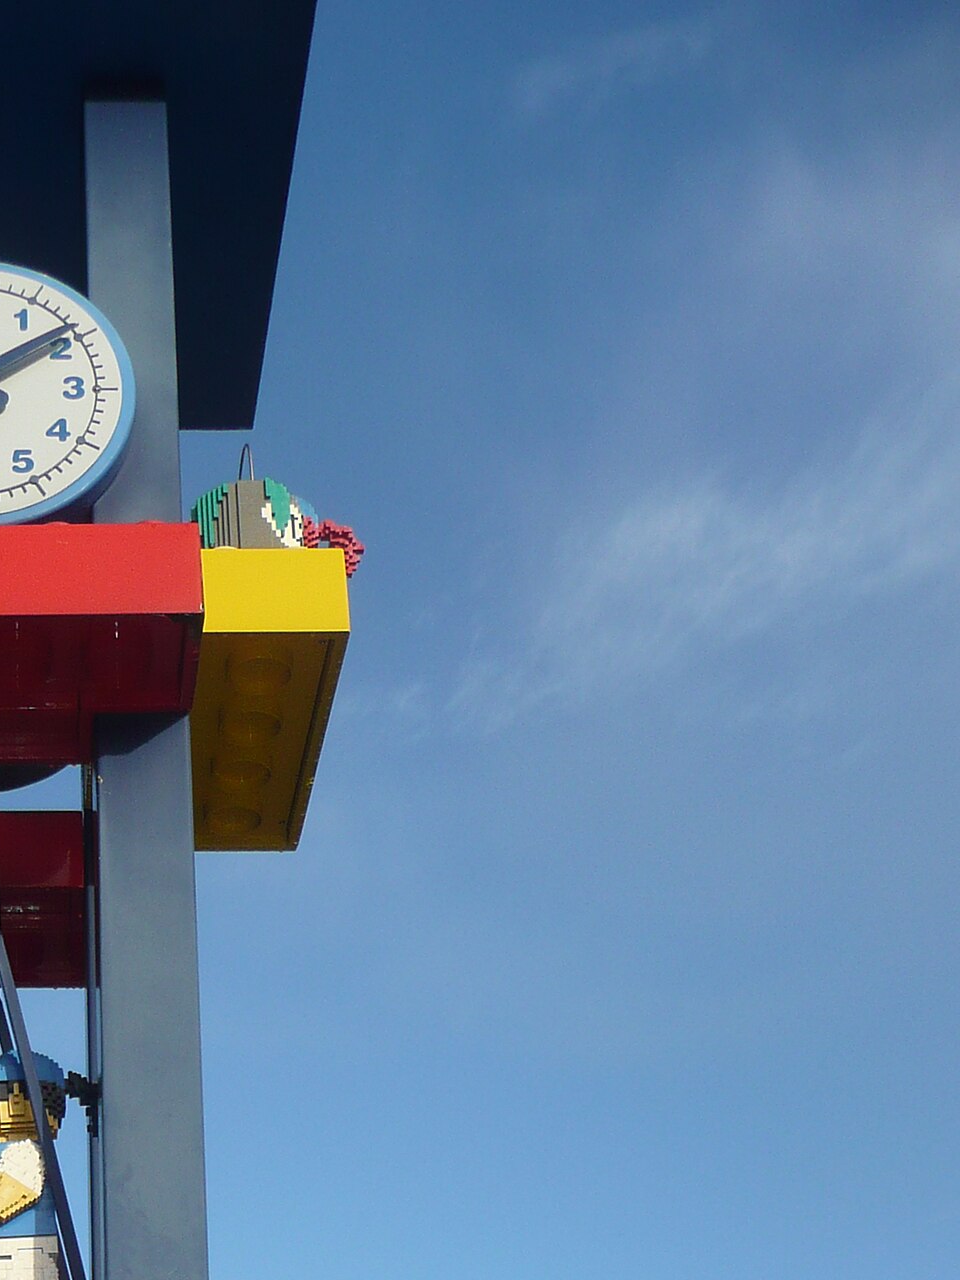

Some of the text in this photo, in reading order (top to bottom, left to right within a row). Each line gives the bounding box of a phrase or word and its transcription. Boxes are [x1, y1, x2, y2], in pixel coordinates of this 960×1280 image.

[13, 309, 29, 331] 1
[49, 337, 73, 361] 2
[62, 376, 86, 400] 3
[45, 418, 71, 442] 4
[11, 449, 35, 474] 5
